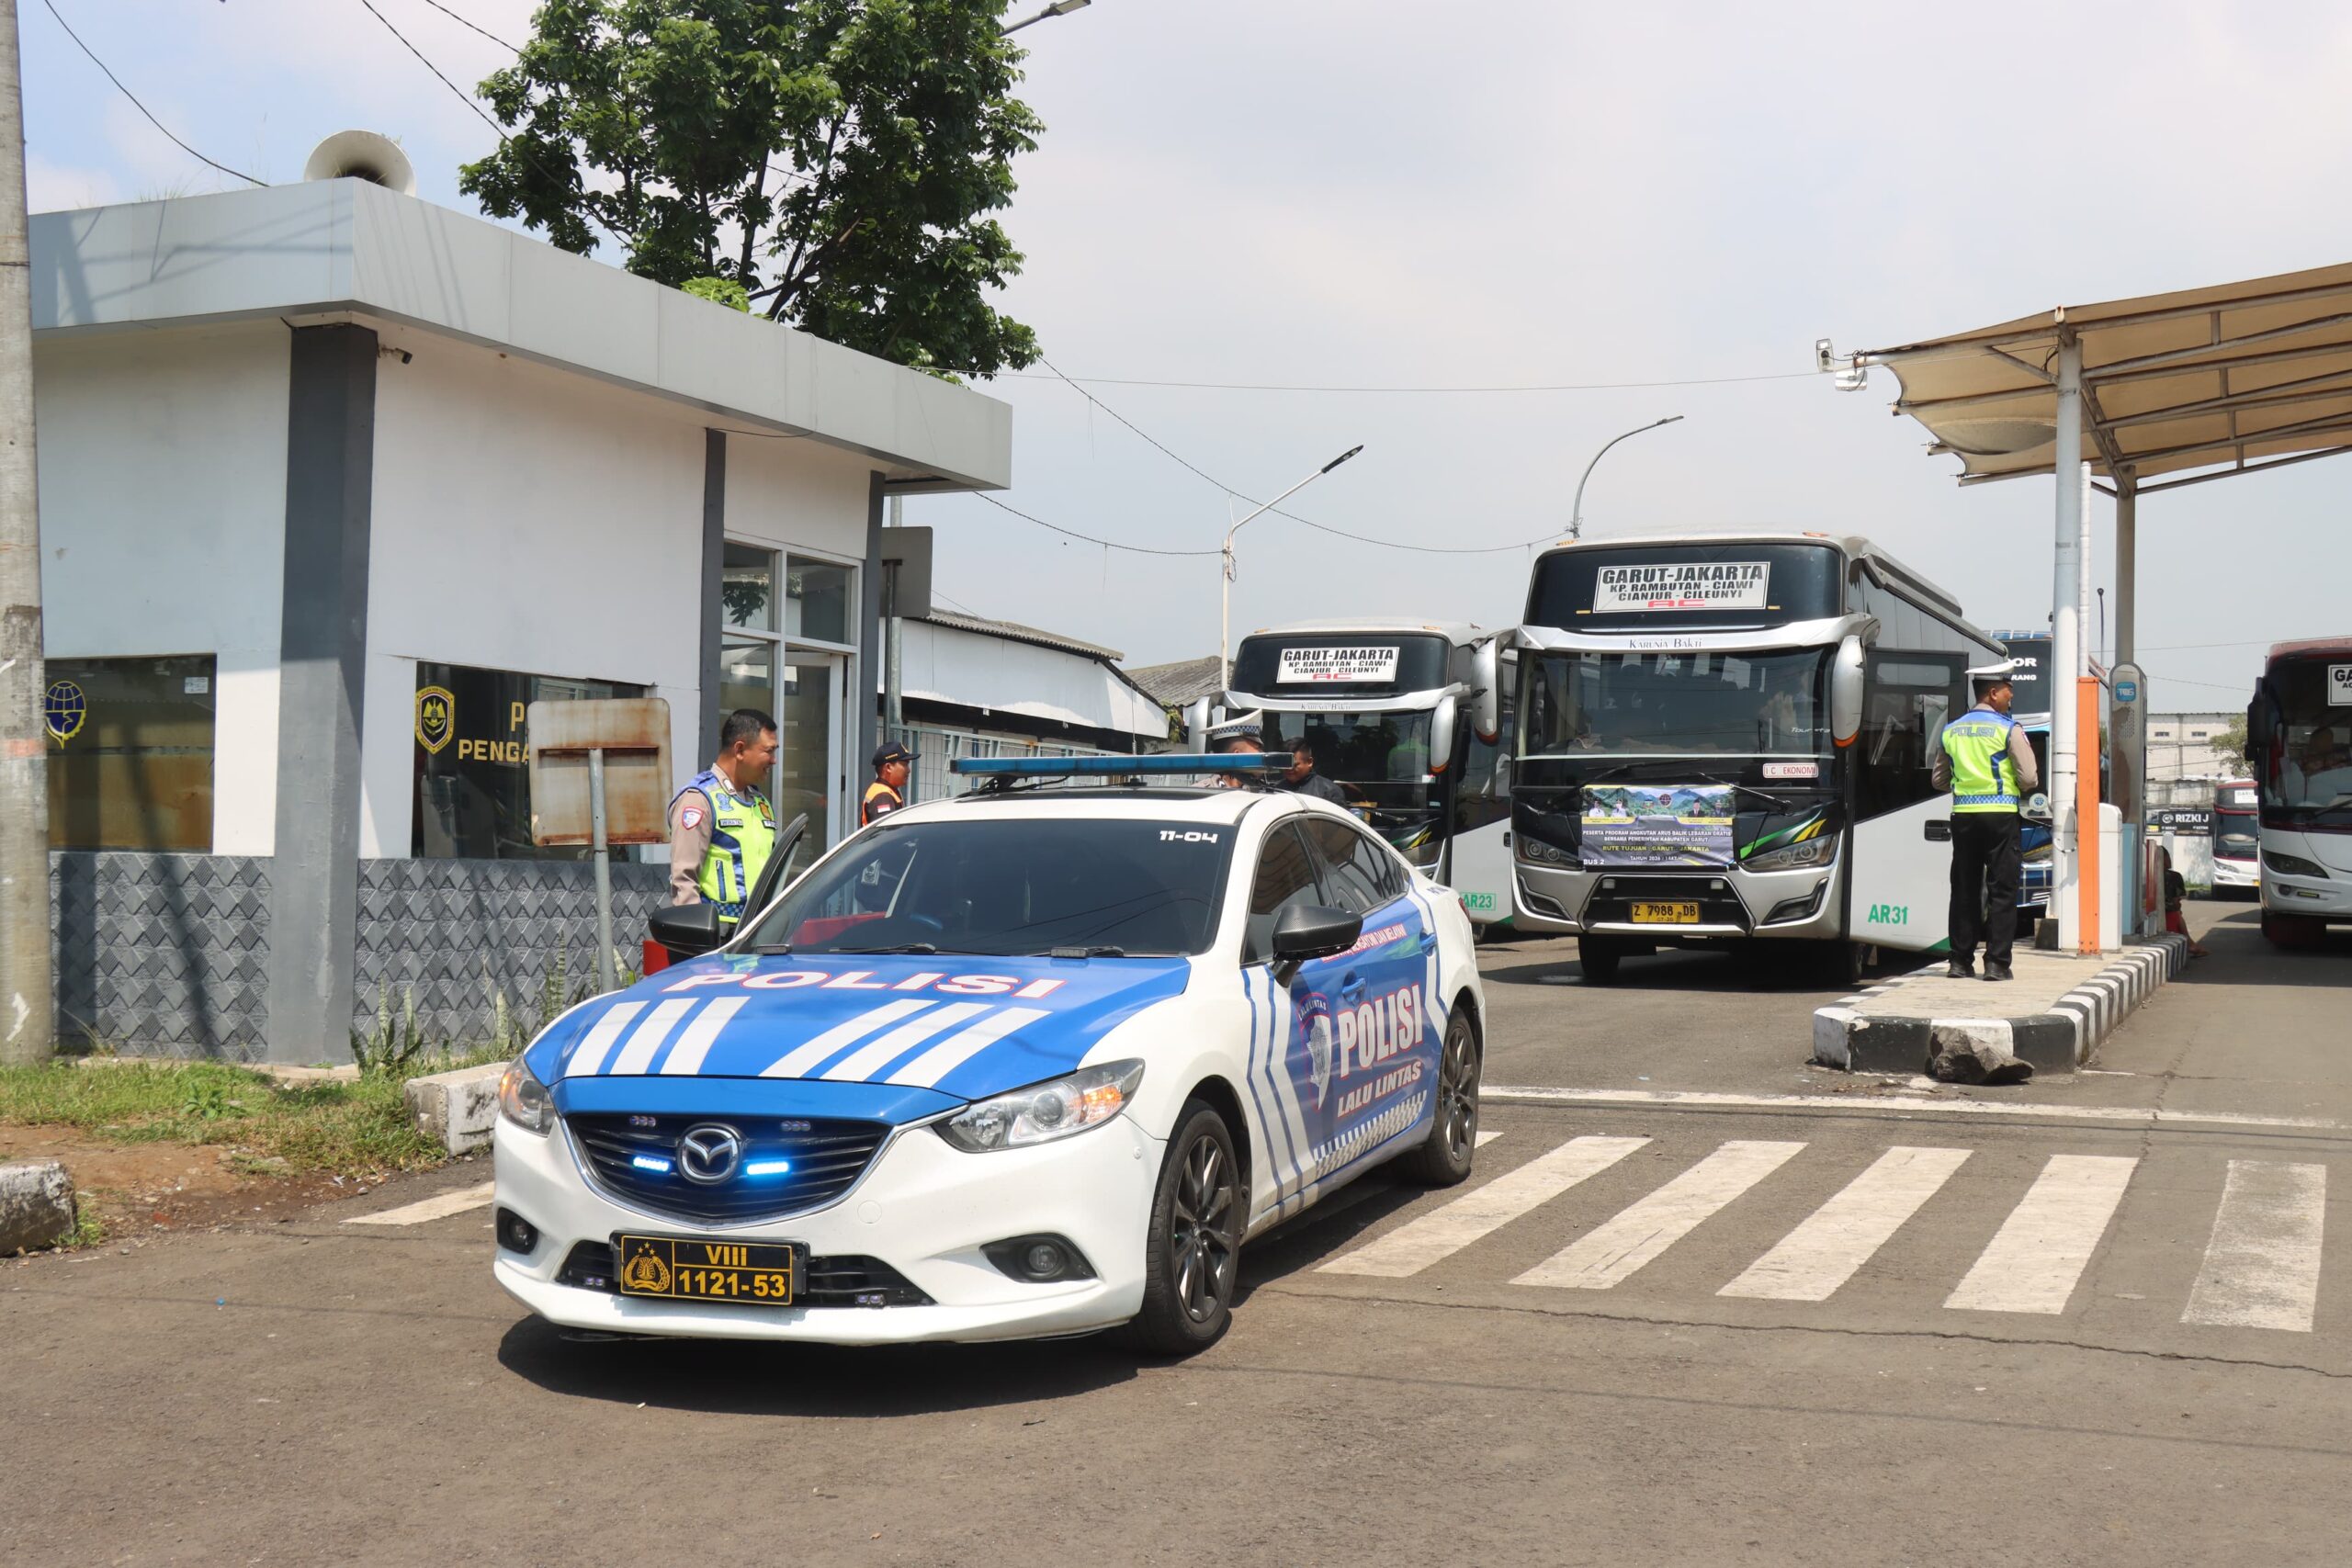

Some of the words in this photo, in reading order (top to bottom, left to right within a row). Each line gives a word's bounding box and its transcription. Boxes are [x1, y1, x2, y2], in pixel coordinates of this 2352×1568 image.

[1602, 565, 1763, 583] GARUT-JAKARTA
[1610, 584, 1628, 592] KP.
[1631, 581, 1701, 592] RAMBUTAN
[1713, 581, 1753, 590] CIAWI
[1618, 592, 1672, 601] CIANJUR
[1683, 590, 1742, 599] CILEUNYI
[1647, 599, 1705, 608] AC
[1283, 649, 1394, 661] GARUT-JAKARTA
[2335, 669, 2352, 682] GA
[1950, 726, 1996, 738] POLISI
[458, 739, 530, 764] PENGA
[1782, 765, 1816, 775] EKONOMI
[2176, 814, 2201, 822] RIZKI
[1159, 830, 1218, 843] 11-04
[1634, 906, 1641, 916] Z
[1647, 906, 1674, 916] 7988
[1683, 905, 1696, 916] DB
[1868, 904, 1908, 925] AR31
[660, 970, 1068, 999] POLISI
[1337, 982, 1424, 1079] POLISI
[1337, 1083, 1373, 1118] LALU
[1374, 1060, 1422, 1100] LINTAS
[706, 1245, 747, 1267] VIII
[679, 1269, 786, 1298] 1121-53
